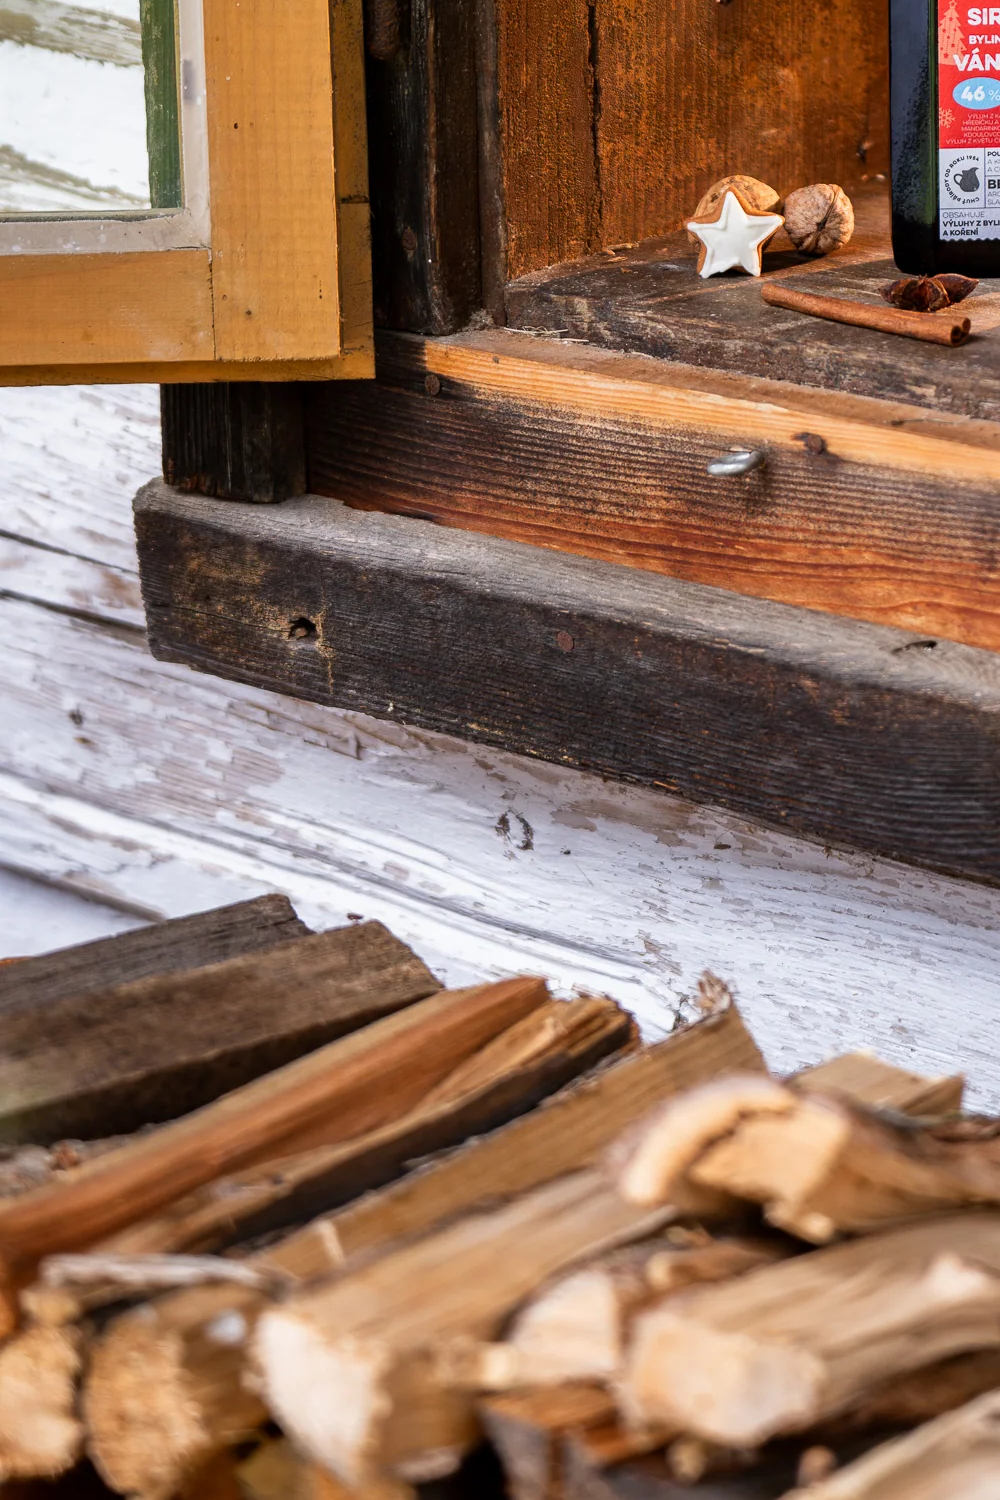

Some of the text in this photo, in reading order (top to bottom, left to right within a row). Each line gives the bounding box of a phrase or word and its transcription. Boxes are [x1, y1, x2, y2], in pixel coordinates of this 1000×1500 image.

[961, 85, 1000, 101] 46 %
[945, 168, 950, 177] OD
[949, 156, 964, 168] ROKU
[942, 211, 985, 219] OBSAHUJE
[942, 219, 975, 227] VÝLUHY
[949, 227, 979, 236] KOŘENÍ
